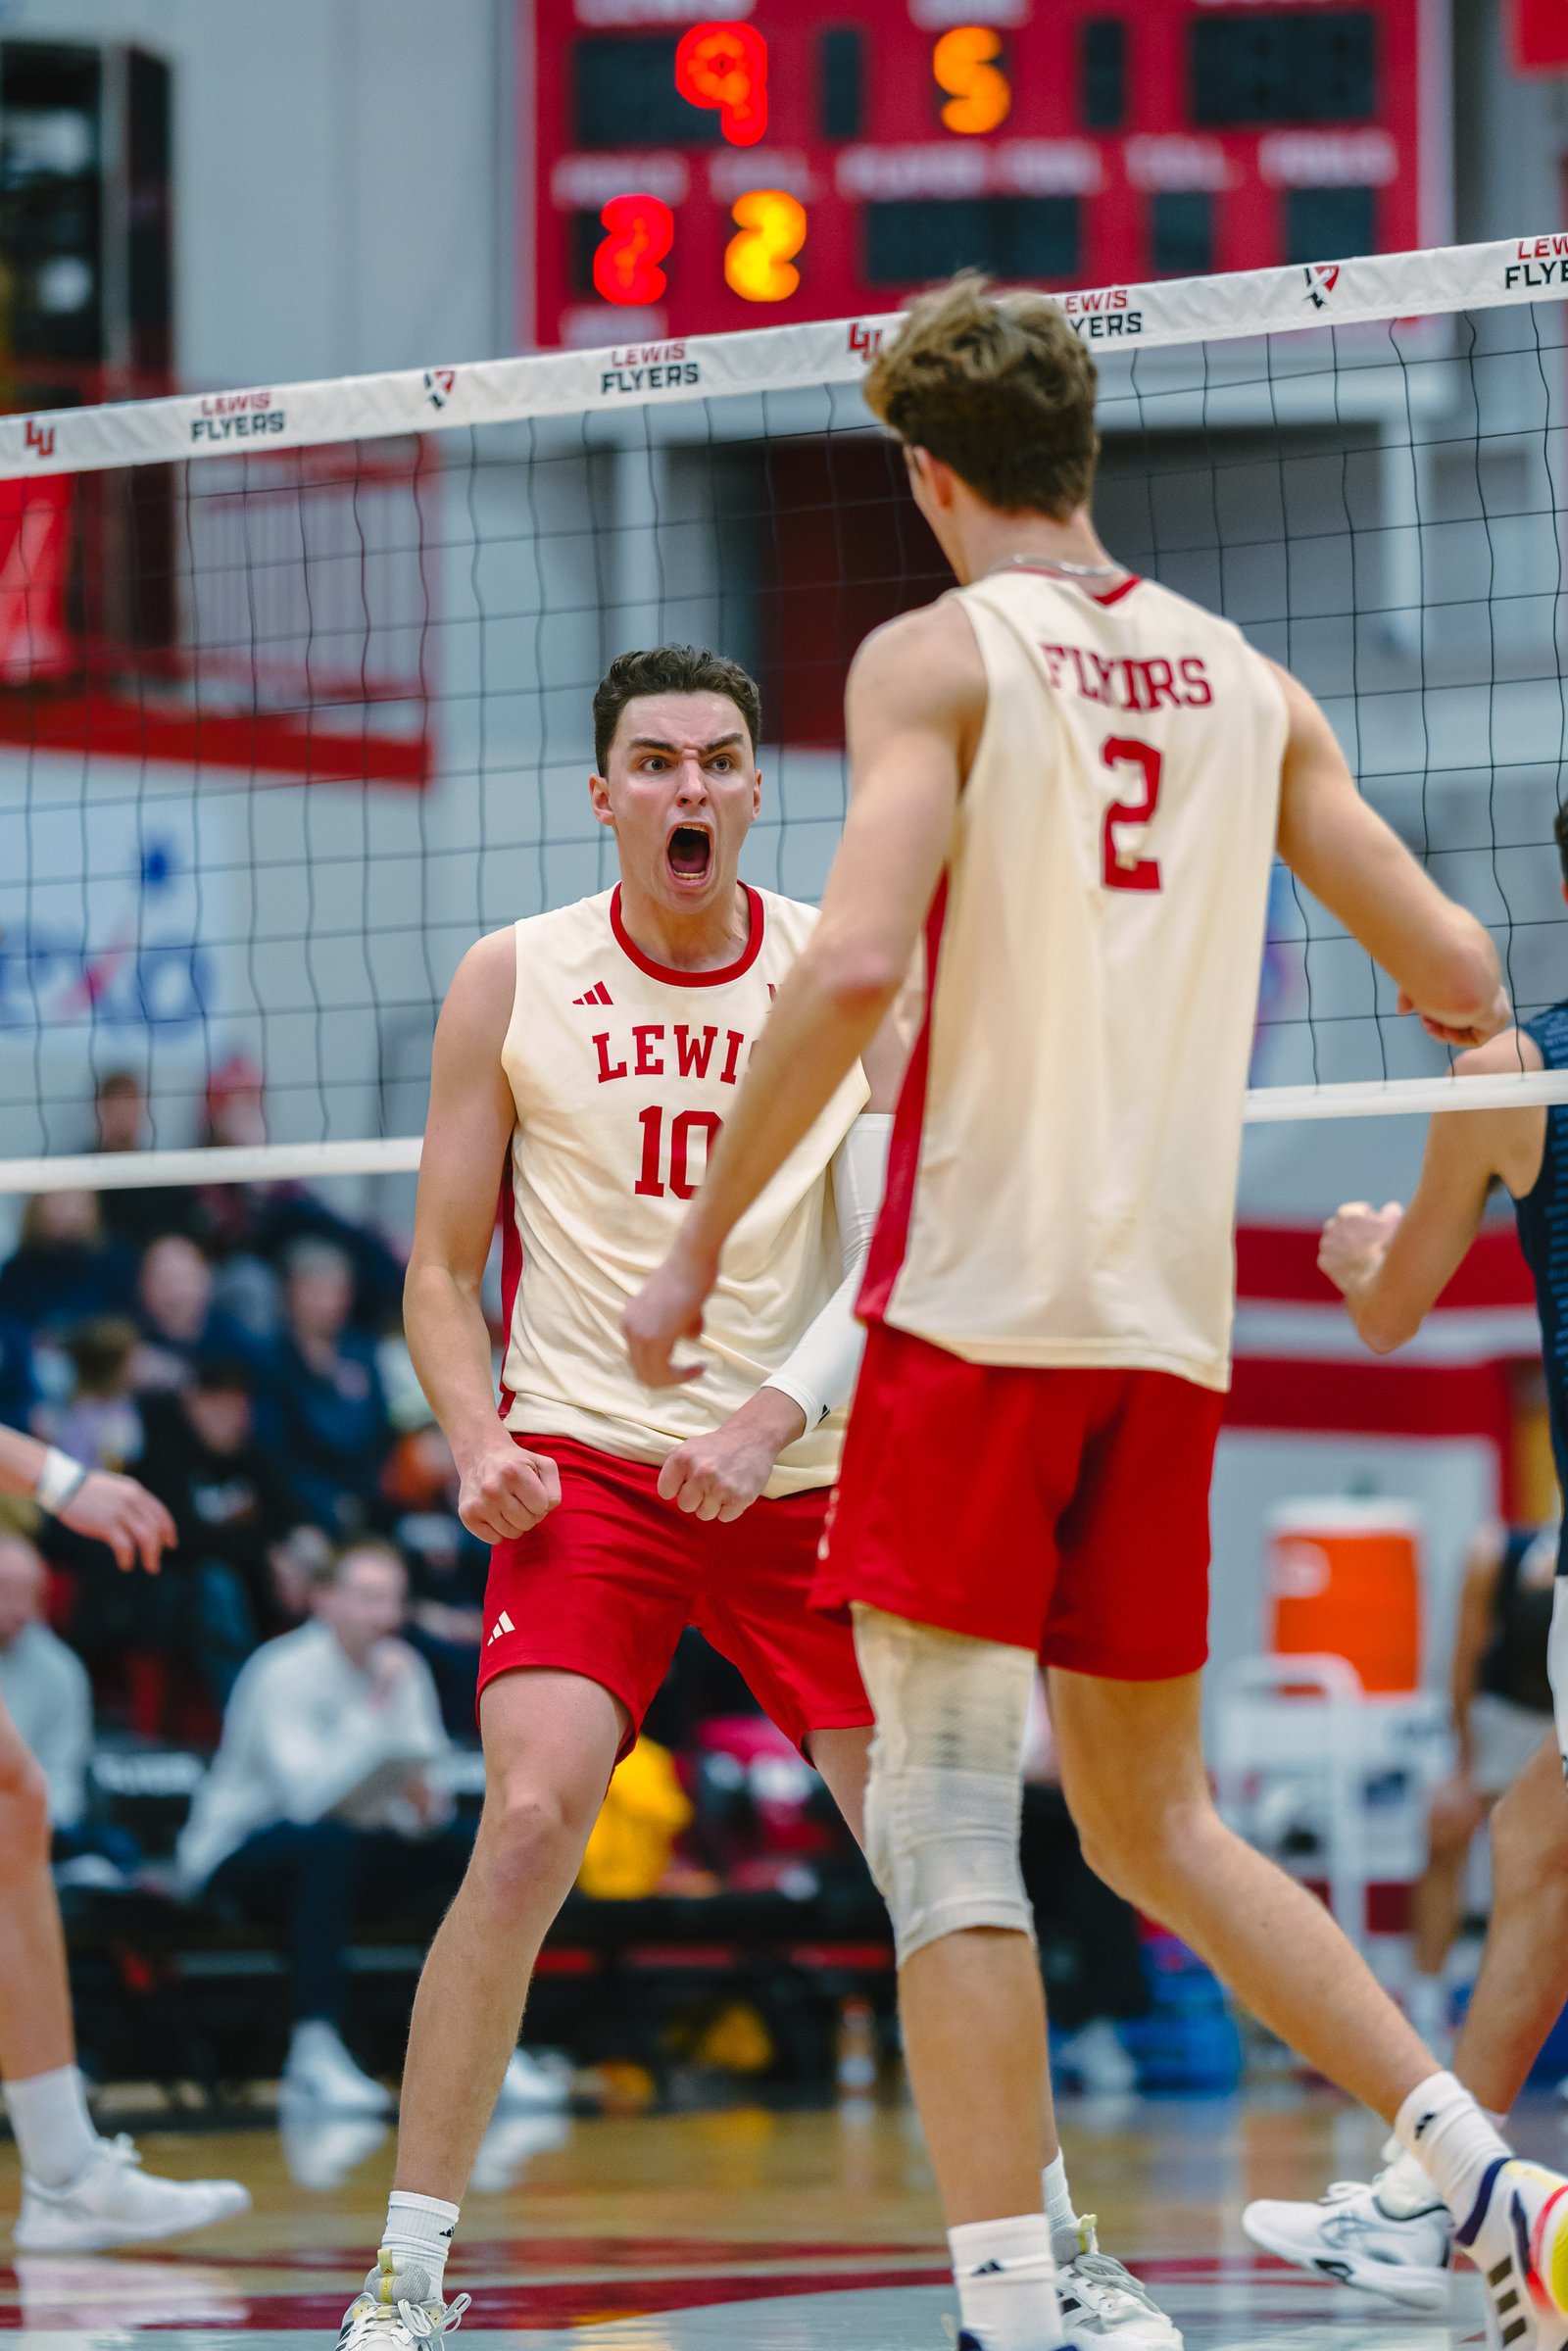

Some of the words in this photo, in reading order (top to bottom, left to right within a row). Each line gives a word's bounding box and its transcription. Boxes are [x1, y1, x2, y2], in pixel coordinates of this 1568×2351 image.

[933, 26, 1010, 134] 5
[1517, 235, 1568, 261] LEW
[1505, 260, 1568, 290] FLYE
[1053, 289, 1128, 314] EWIS
[1069, 312, 1143, 338] YERS
[611, 341, 686, 368] LEWIS
[600, 363, 700, 394] FLYERS
[201, 391, 272, 416] LEWIS
[190, 411, 286, 442] FLYERS
[1100, 734, 1163, 894] 2
[591, 1024, 760, 1086] LEWI
[634, 1104, 725, 1200] 10
